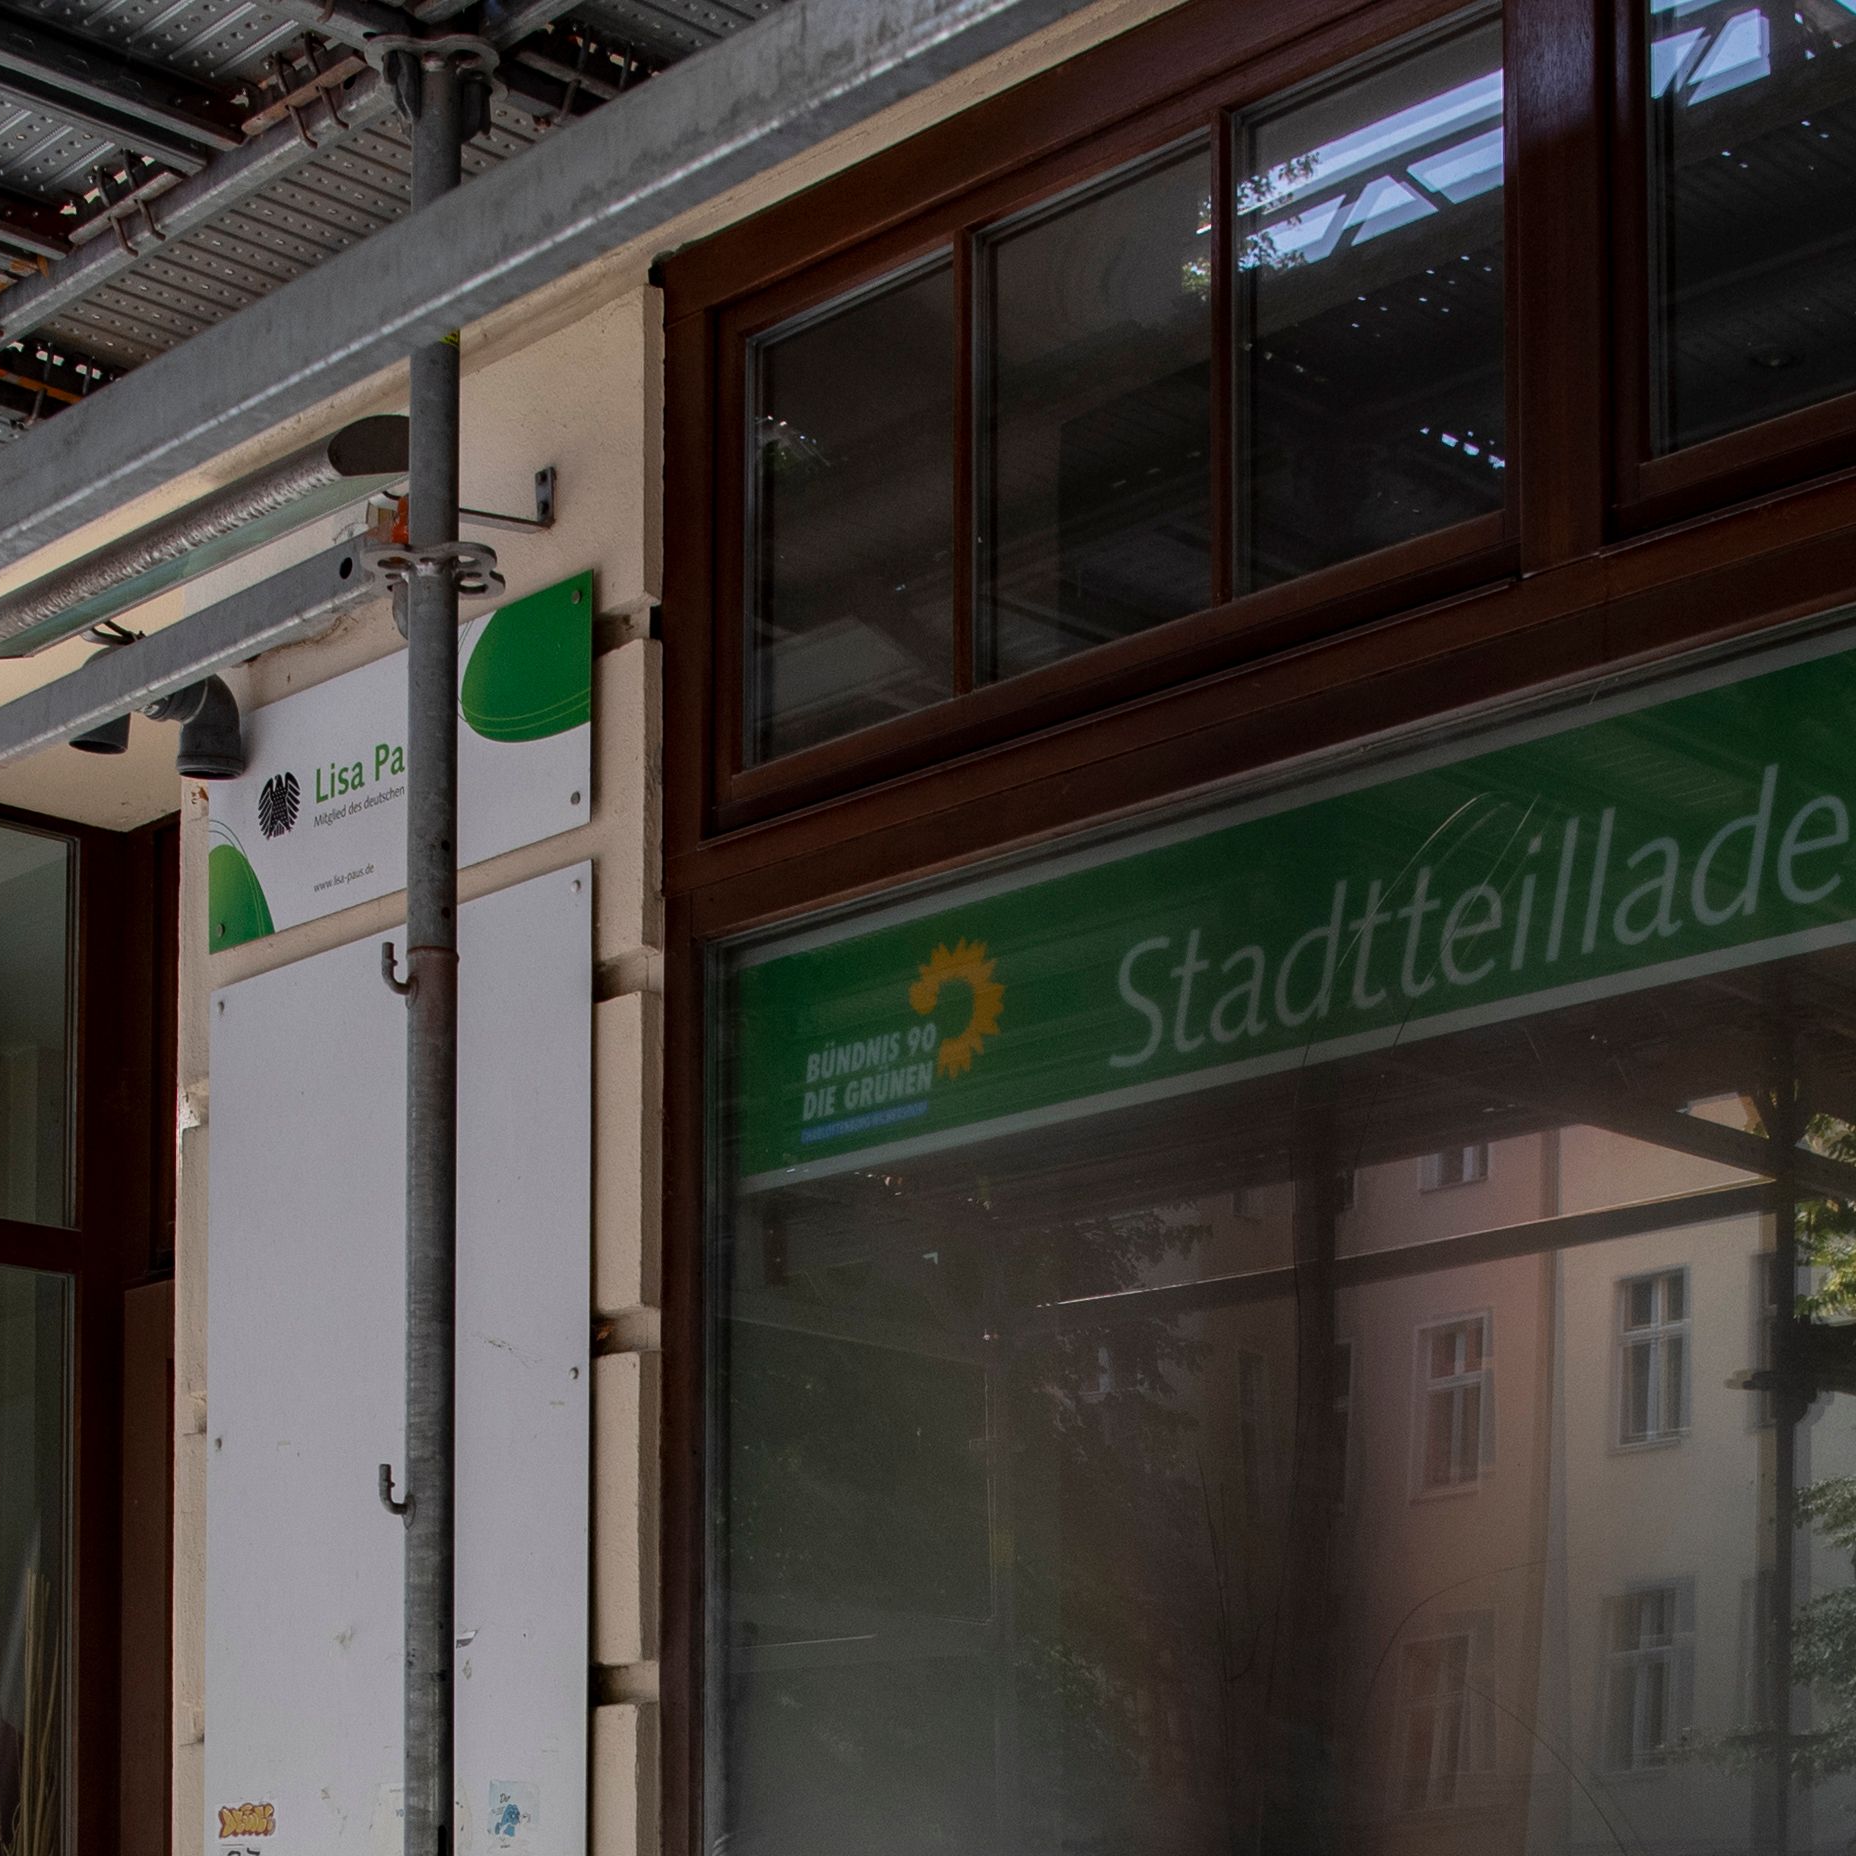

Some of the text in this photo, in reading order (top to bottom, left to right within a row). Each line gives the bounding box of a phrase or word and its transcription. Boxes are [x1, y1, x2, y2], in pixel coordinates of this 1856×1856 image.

[316, 743, 406, 804] Lisa Pa
[313, 786, 405, 828] Mitglied des deutschen
[313, 863, 374, 893] www.lisa-paus.de
[806, 1023, 937, 1084] BÜNDNIS 90
[802, 1060, 934, 1121] DIE GRÜNEN
